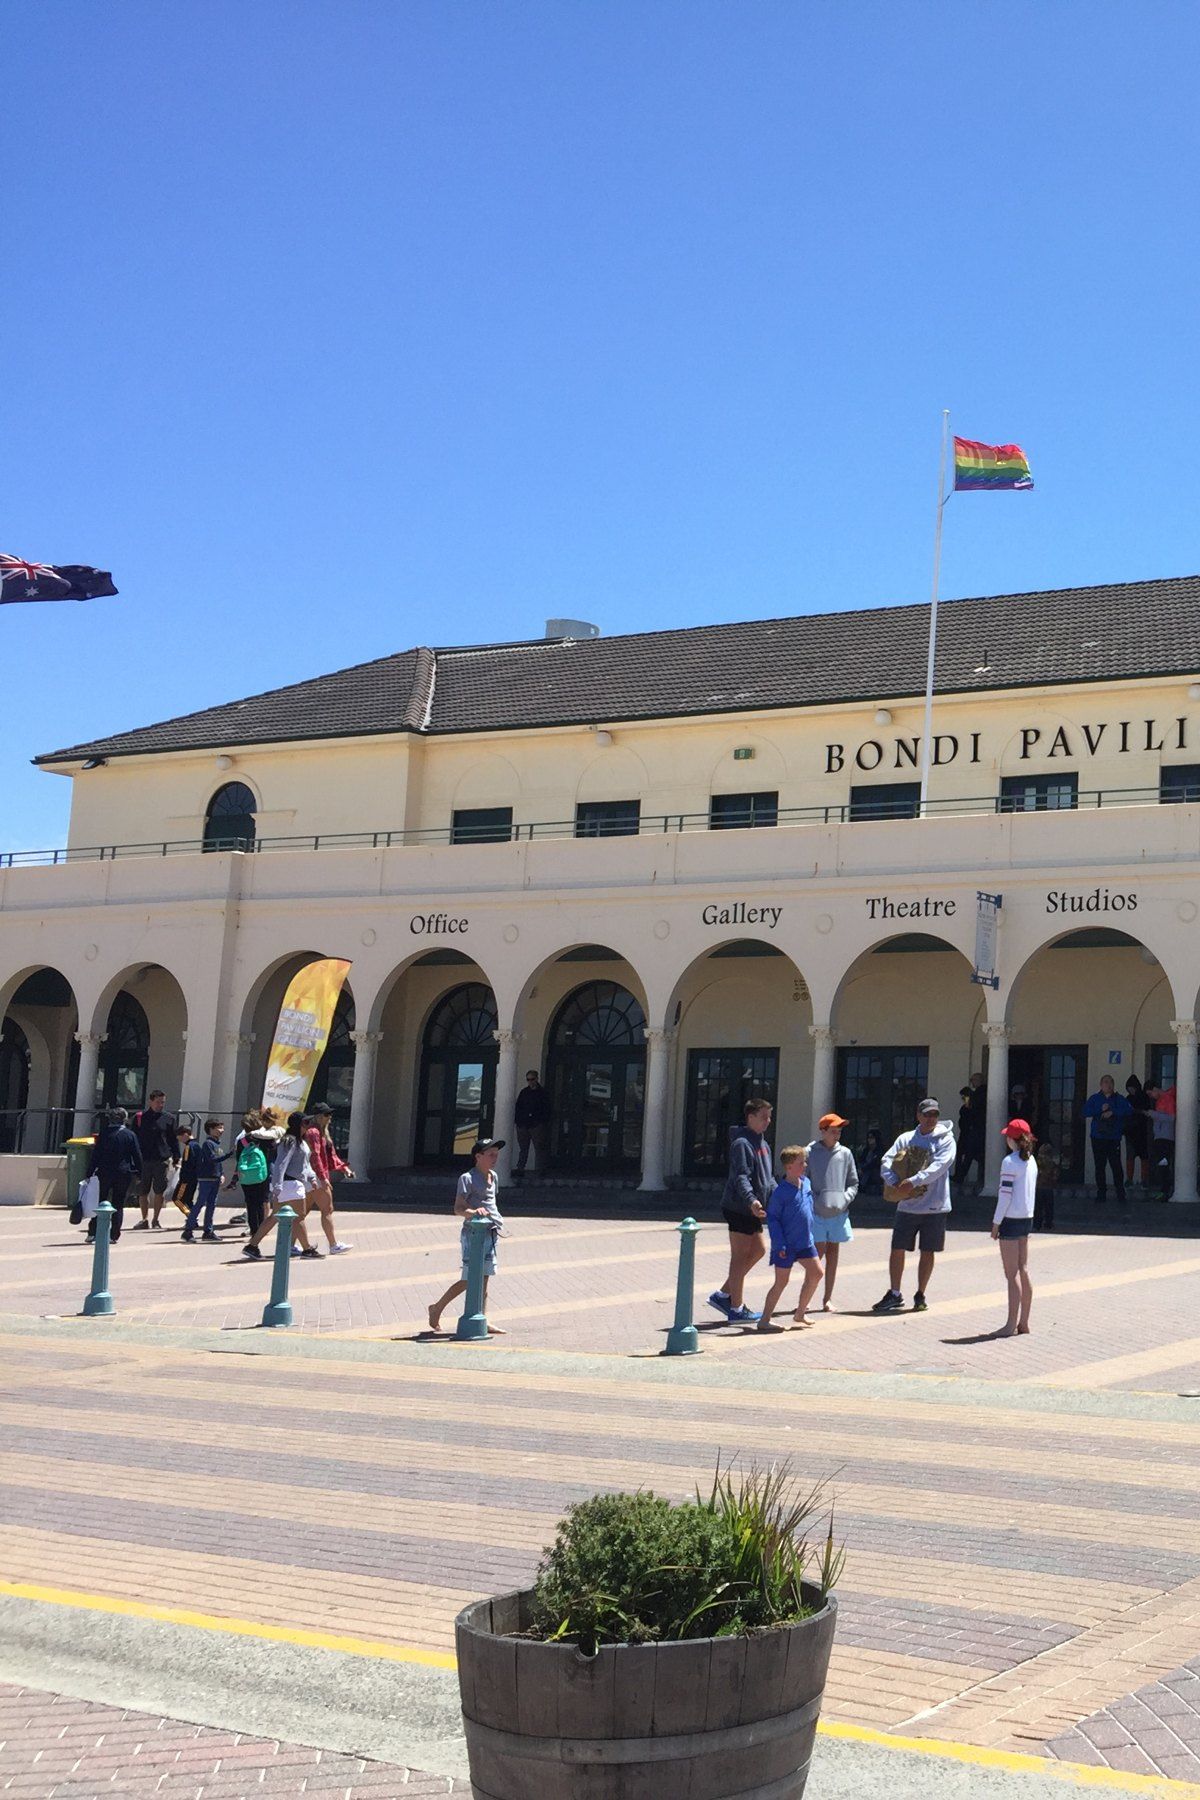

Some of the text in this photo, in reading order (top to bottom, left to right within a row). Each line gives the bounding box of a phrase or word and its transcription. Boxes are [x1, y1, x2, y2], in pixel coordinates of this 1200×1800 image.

[825, 734, 981, 774] BONDI
[866, 897, 956, 919] Theatre
[1046, 888, 1137, 913] Studios
[410, 914, 468, 934] Office
[703, 902, 783, 928] Gallery
